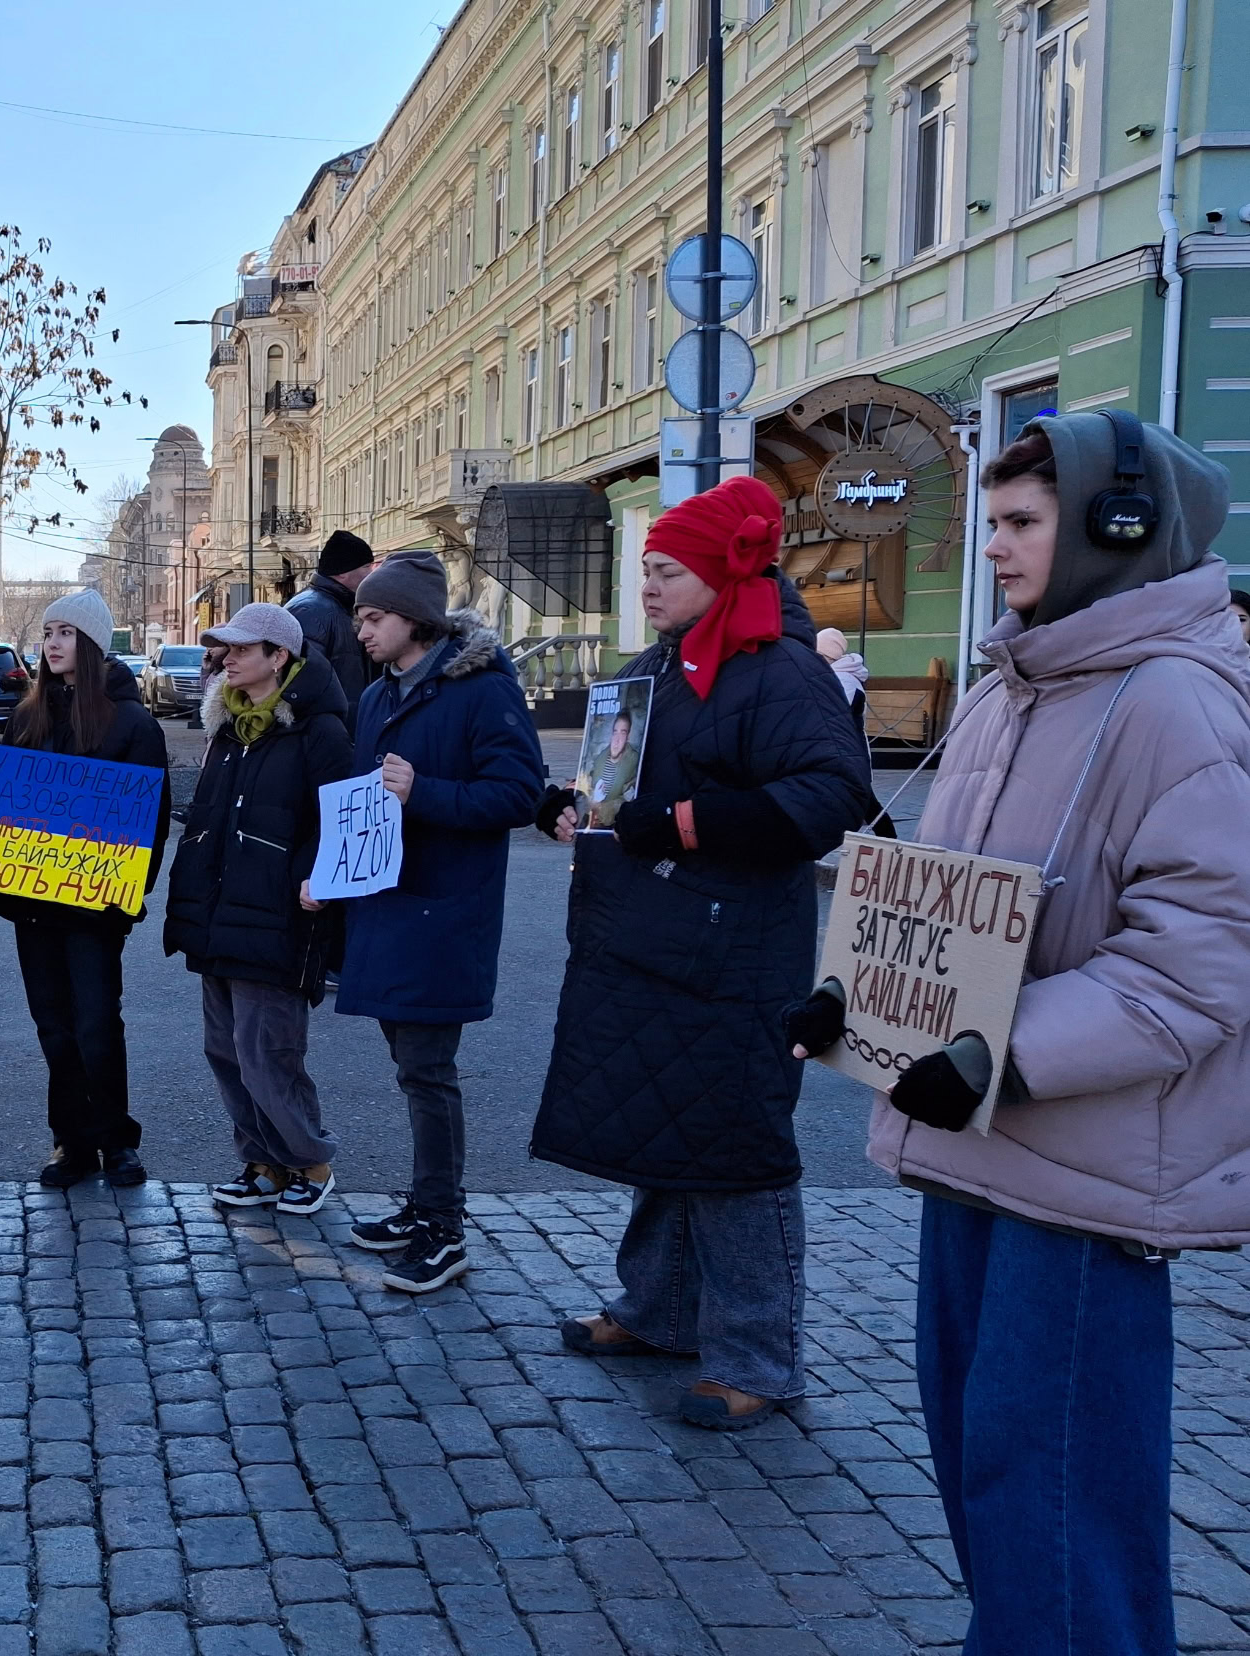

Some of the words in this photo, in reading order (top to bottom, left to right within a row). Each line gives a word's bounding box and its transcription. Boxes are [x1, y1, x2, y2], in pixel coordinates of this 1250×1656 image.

[590, 701, 597, 715] 5
[592, 685, 619, 701] ПОЛОН
[15, 755, 162, 800] ПОЛОНЕНИХ
[0, 781, 154, 830] АЗОВСТАЛІ
[338, 780, 390, 834] #FREE
[2, 840, 126, 879] БАЙДУЖИХ
[63, 823, 140, 860] РАНИ
[331, 822, 395, 884] AZOV
[55, 872, 137, 909] ДУШІ
[850, 844, 1027, 943] БАЙДУЖІСТЬ
[851, 904, 953, 976] ЗАТЯГУЄ
[849, 959, 958, 1042] КАЙДАНИ
